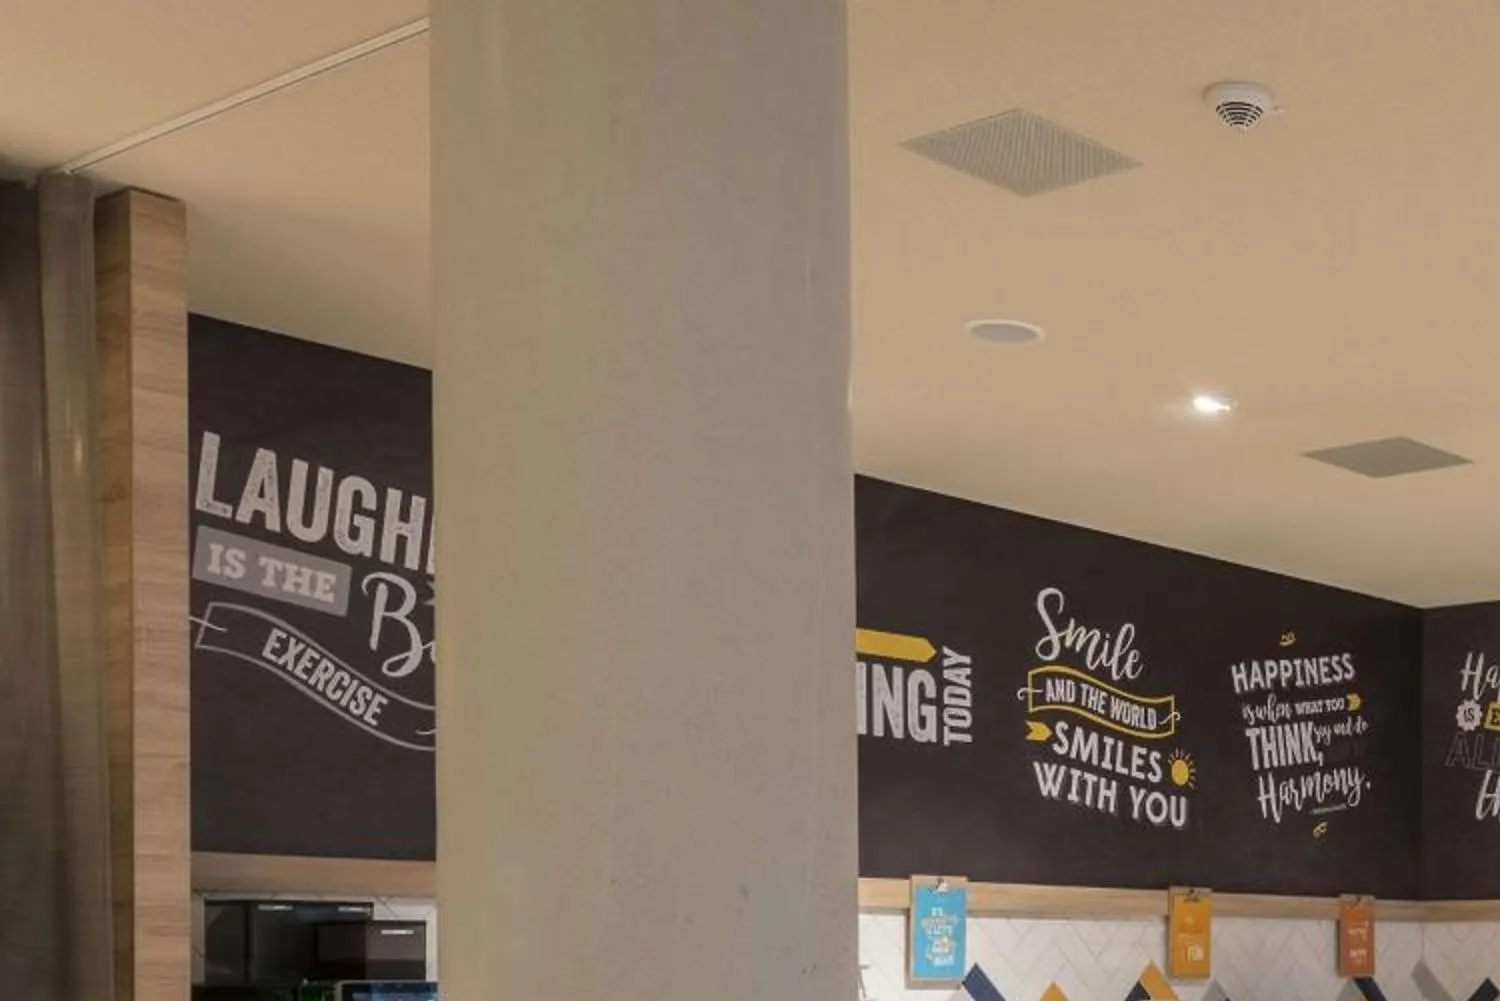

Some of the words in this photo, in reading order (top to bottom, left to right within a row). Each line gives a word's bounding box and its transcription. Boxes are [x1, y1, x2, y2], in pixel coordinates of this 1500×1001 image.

[195, 431, 436, 574] LAUGH
[207, 542, 246, 580] IS
[259, 555, 338, 604] THE
[362, 571, 436, 678] B
[1035, 587, 1144, 681] Smile
[261, 627, 388, 728] EXERCISE
[943, 645, 973, 747] TODAY
[1045, 677, 1076, 703] AND
[1080, 683, 1107, 713] THE
[1110, 693, 1158, 730] WORLD
[1231, 652, 1356, 694] HAPPINESS
[1052, 720, 1163, 783] SMILES
[1245, 721, 1324, 771] THINK,
[1033, 761, 1118, 813] WITH
[1129, 785, 1188, 828] YOU
[1256, 766, 1372, 823] Harmony.
